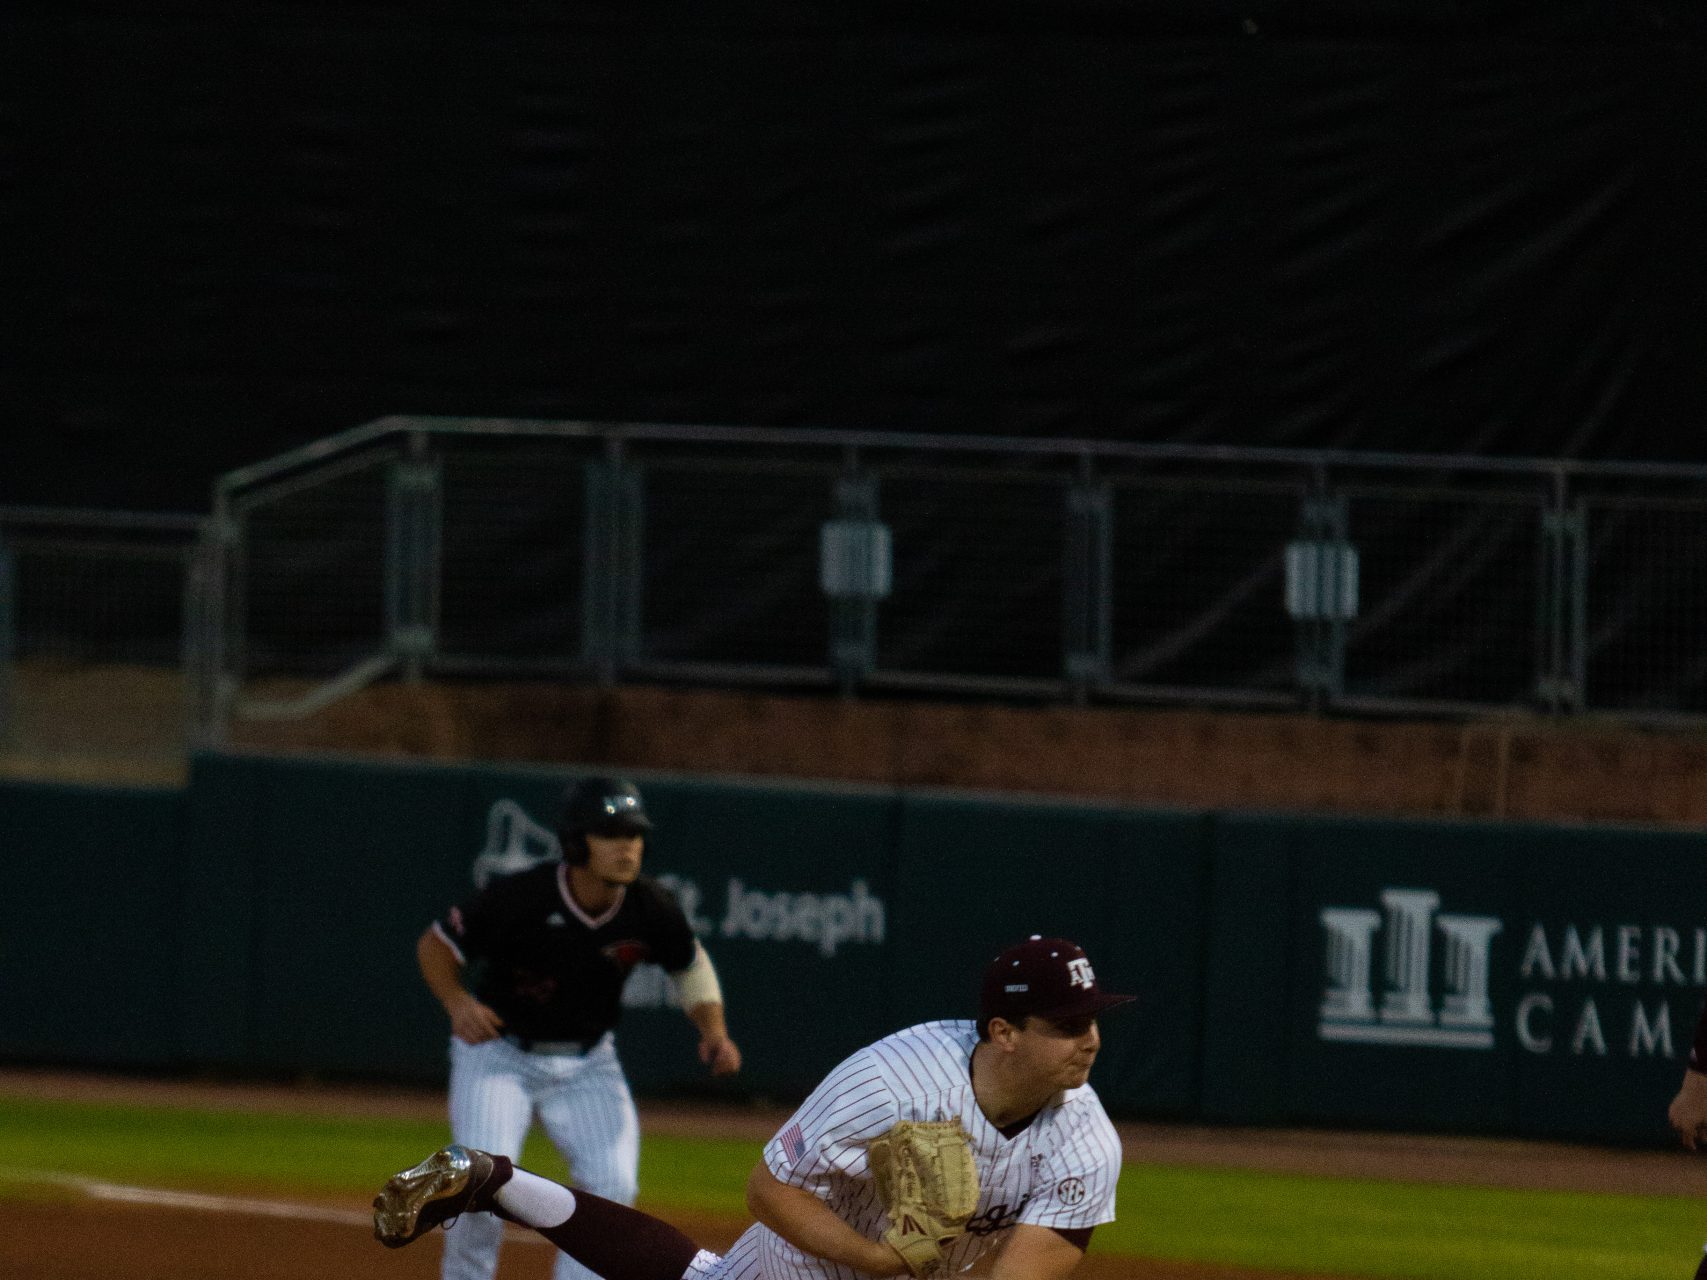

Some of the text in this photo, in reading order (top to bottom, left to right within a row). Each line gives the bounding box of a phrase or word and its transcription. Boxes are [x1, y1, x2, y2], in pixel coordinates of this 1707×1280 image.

[721, 877, 886, 957] Joseph
[1519, 922, 1707, 985] AMERI
[1059, 1181, 1085, 1203] SEC
